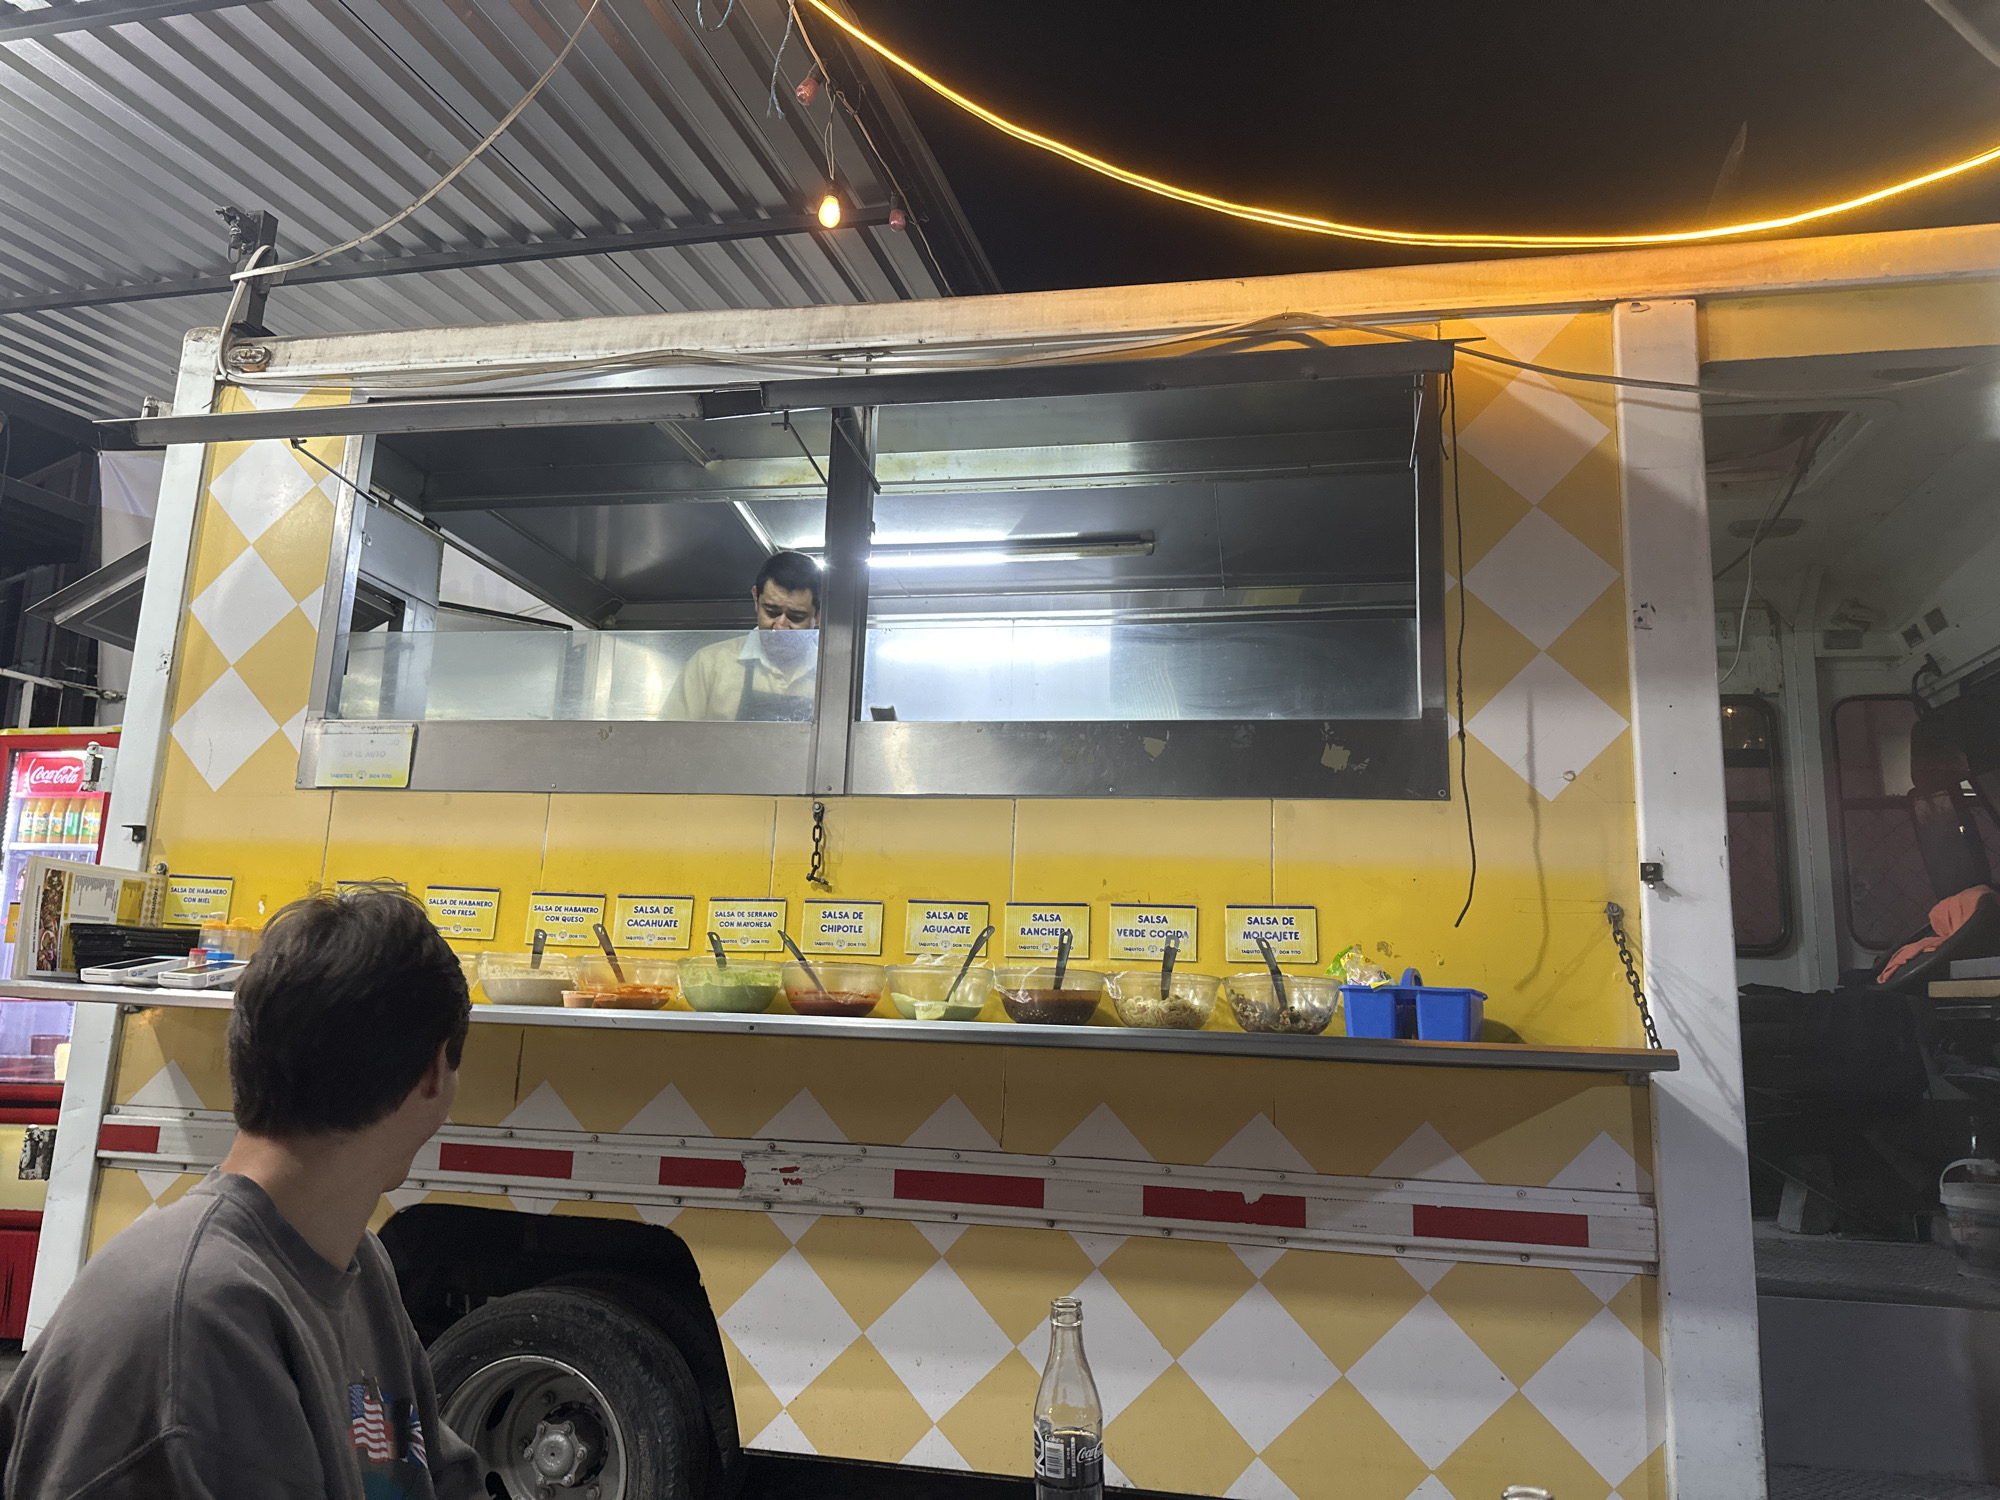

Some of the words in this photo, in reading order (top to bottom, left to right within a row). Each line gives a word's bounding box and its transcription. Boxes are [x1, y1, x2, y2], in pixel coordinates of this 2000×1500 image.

[30, 765, 83, 785] Coca-Cola
[170, 886, 187, 894] SALSA
[196, 887, 228, 895] HABANERO
[150, 888, 159, 919] TAQUITOS
[428, 898, 448, 906] SALSA
[458, 900, 493, 908] HABANERO
[441, 908, 456, 916] CON
[457, 909, 476, 917] FRESA
[563, 906, 599, 914] HABANERO
[633, 905, 661, 914] SALSA
[663, 906, 675, 915] DE
[821, 911, 850, 919] SALSA
[852, 911, 864, 920] DE
[925, 911, 954, 920] SALSA
[957, 911, 969, 921] DE
[1032, 913, 1062, 922] SALSA
[1137, 915, 1169, 924] SALSA
[626, 919, 679, 928] CACAHUATE
[736, 921, 772, 929] MAYONESA
[1246, 916, 1279, 926] SALSA
[1281, 916, 1295, 926] DE
[820, 924, 864, 934] CHIPOTLE
[922, 925, 971, 935] AGUACATE
[1116, 928, 1146, 938] VERDE
